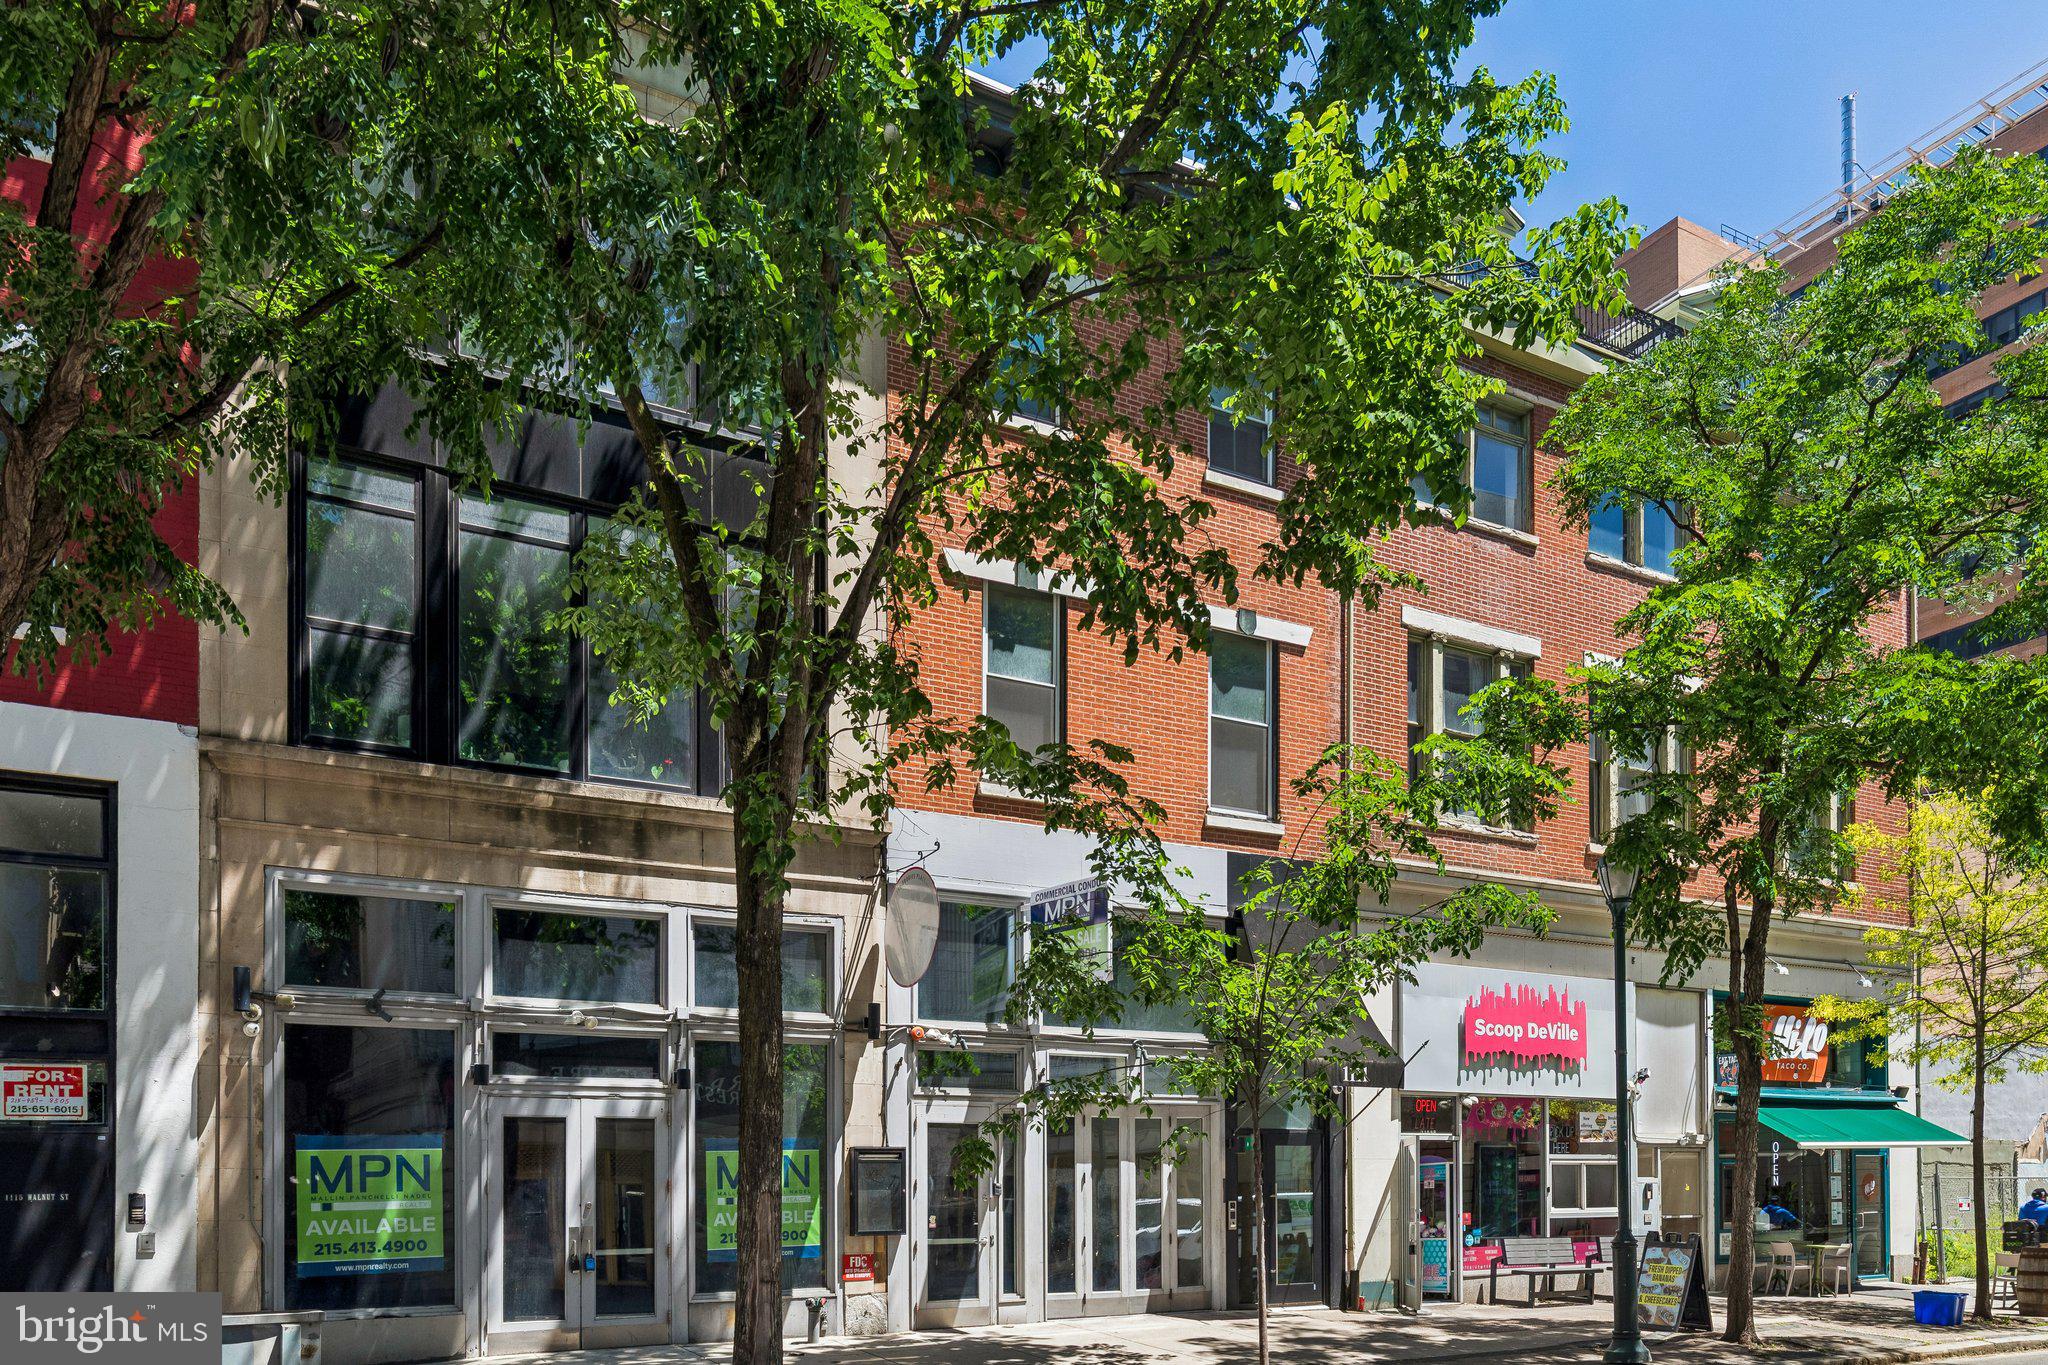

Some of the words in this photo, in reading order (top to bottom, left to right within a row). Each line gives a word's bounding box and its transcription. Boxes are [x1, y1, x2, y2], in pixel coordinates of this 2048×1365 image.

[1035, 884, 1076, 902] COMMERCIAL
[1044, 892, 1091, 922] MPN
[1474, 1018, 1524, 1043] Scoop
[1527, 1021, 1579, 1041] DeVille
[1776, 1061, 1795, 1070] TACO
[23, 1069, 65, 1082] FOR
[13, 1084, 74, 1098] RENT
[10, 1105, 79, 1114] 215-651-6015
[1415, 1098, 1437, 1113] OPEN
[1552, 1141, 1570, 1154] HERE
[717, 1154, 810, 1190] MN
[1771, 1141, 1780, 1187] OPEN
[310, 1154, 431, 1194] MPN
[27, 1193, 55, 1201] WALNUT
[60, 1193, 69, 1201] ST
[305, 1217, 436, 1236] AVAILABLE
[714, 1211, 814, 1227] AVBLE
[314, 1239, 428, 1255] 215.413.4900
[335, 1262, 409, 1272] www.mpnrealty.com
